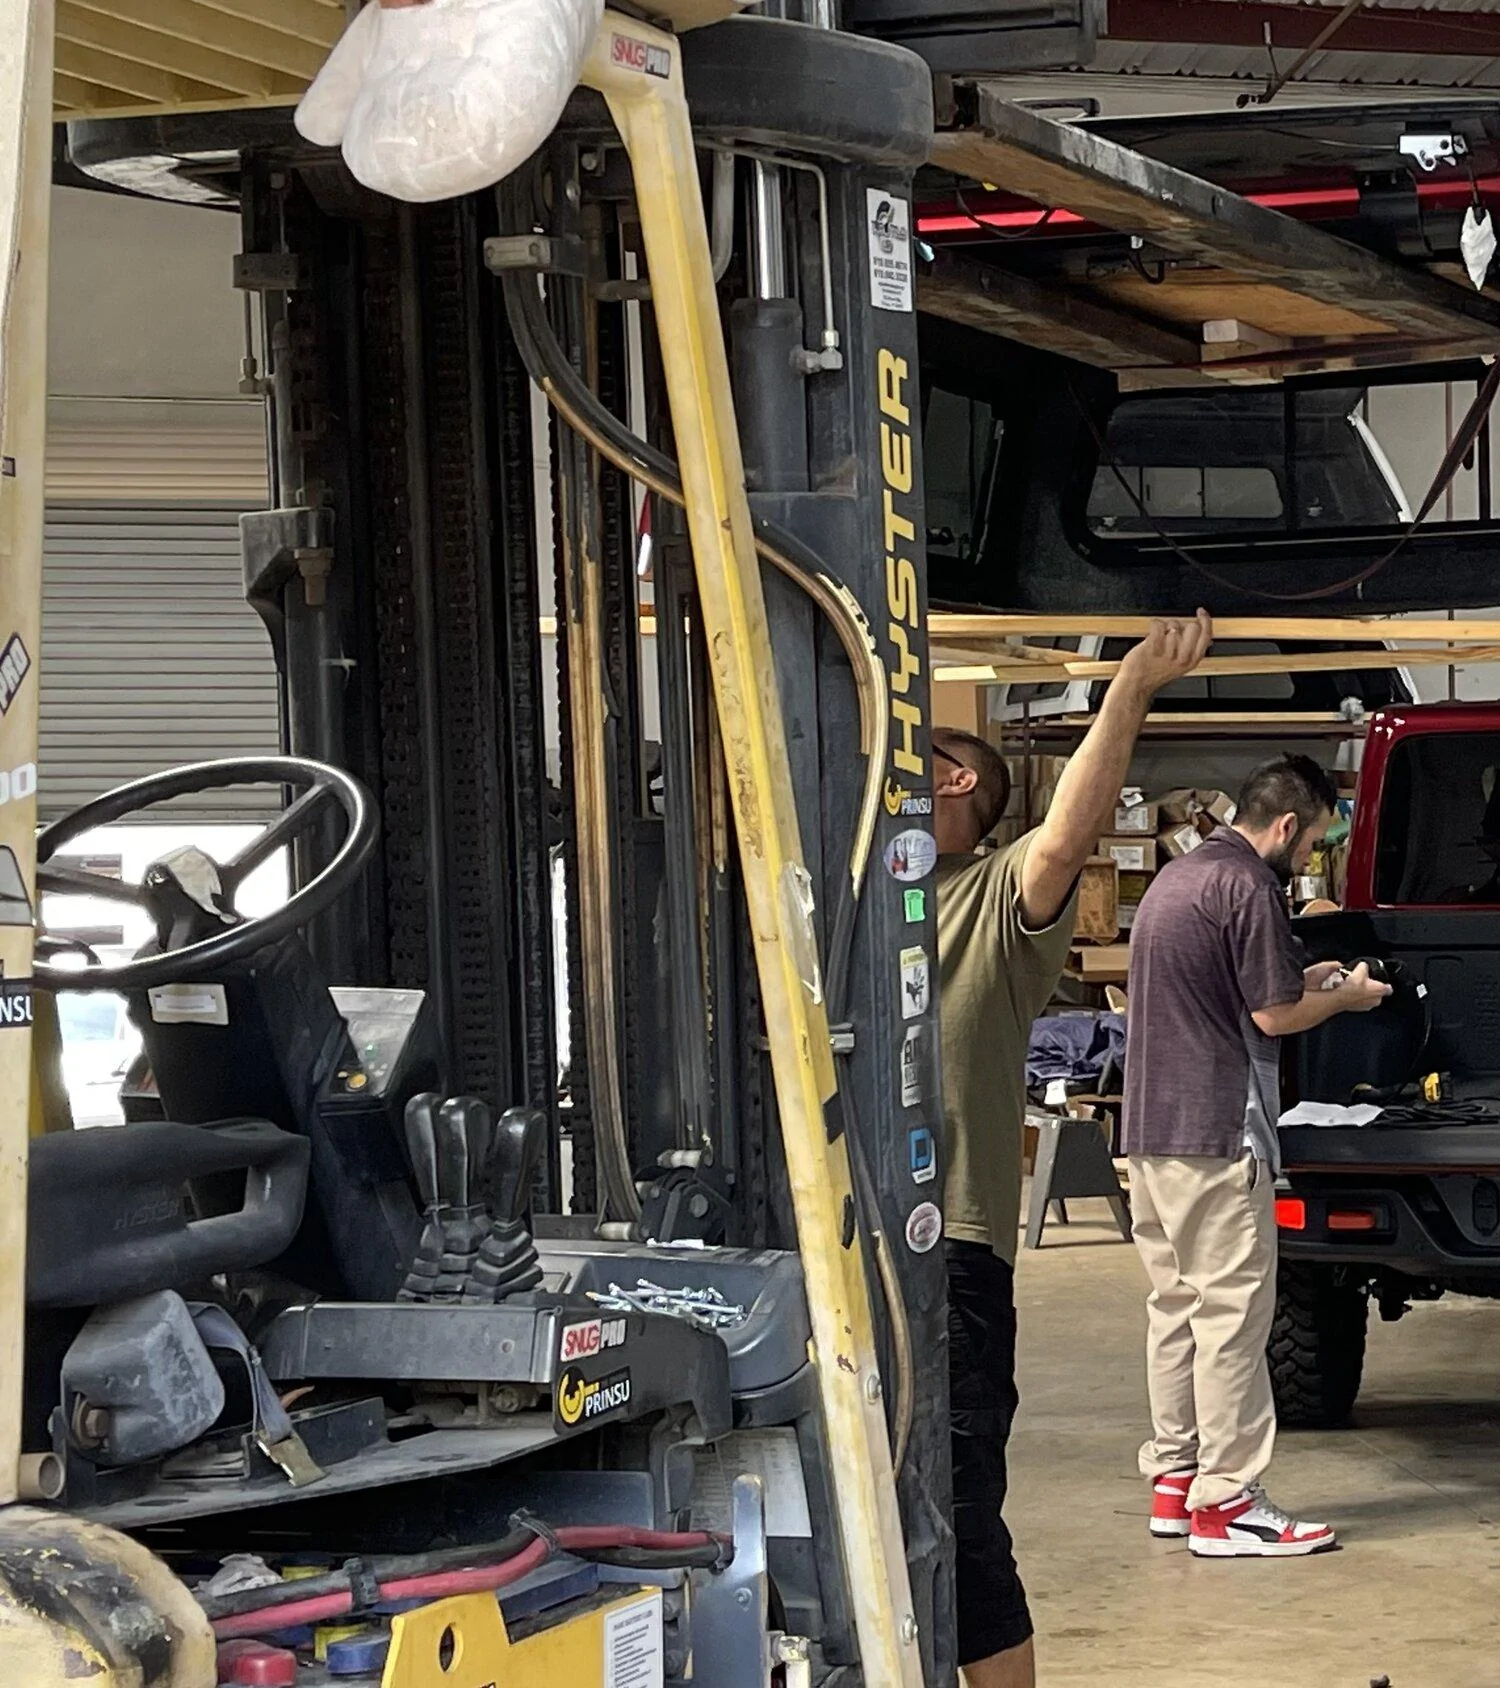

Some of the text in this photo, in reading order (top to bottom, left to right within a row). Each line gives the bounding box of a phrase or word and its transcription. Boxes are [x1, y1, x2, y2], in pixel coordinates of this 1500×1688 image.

[876, 347, 925, 777] HYSTER
[564, 1324, 600, 1357] SNUG
[585, 1379, 631, 1418] PRINSU
